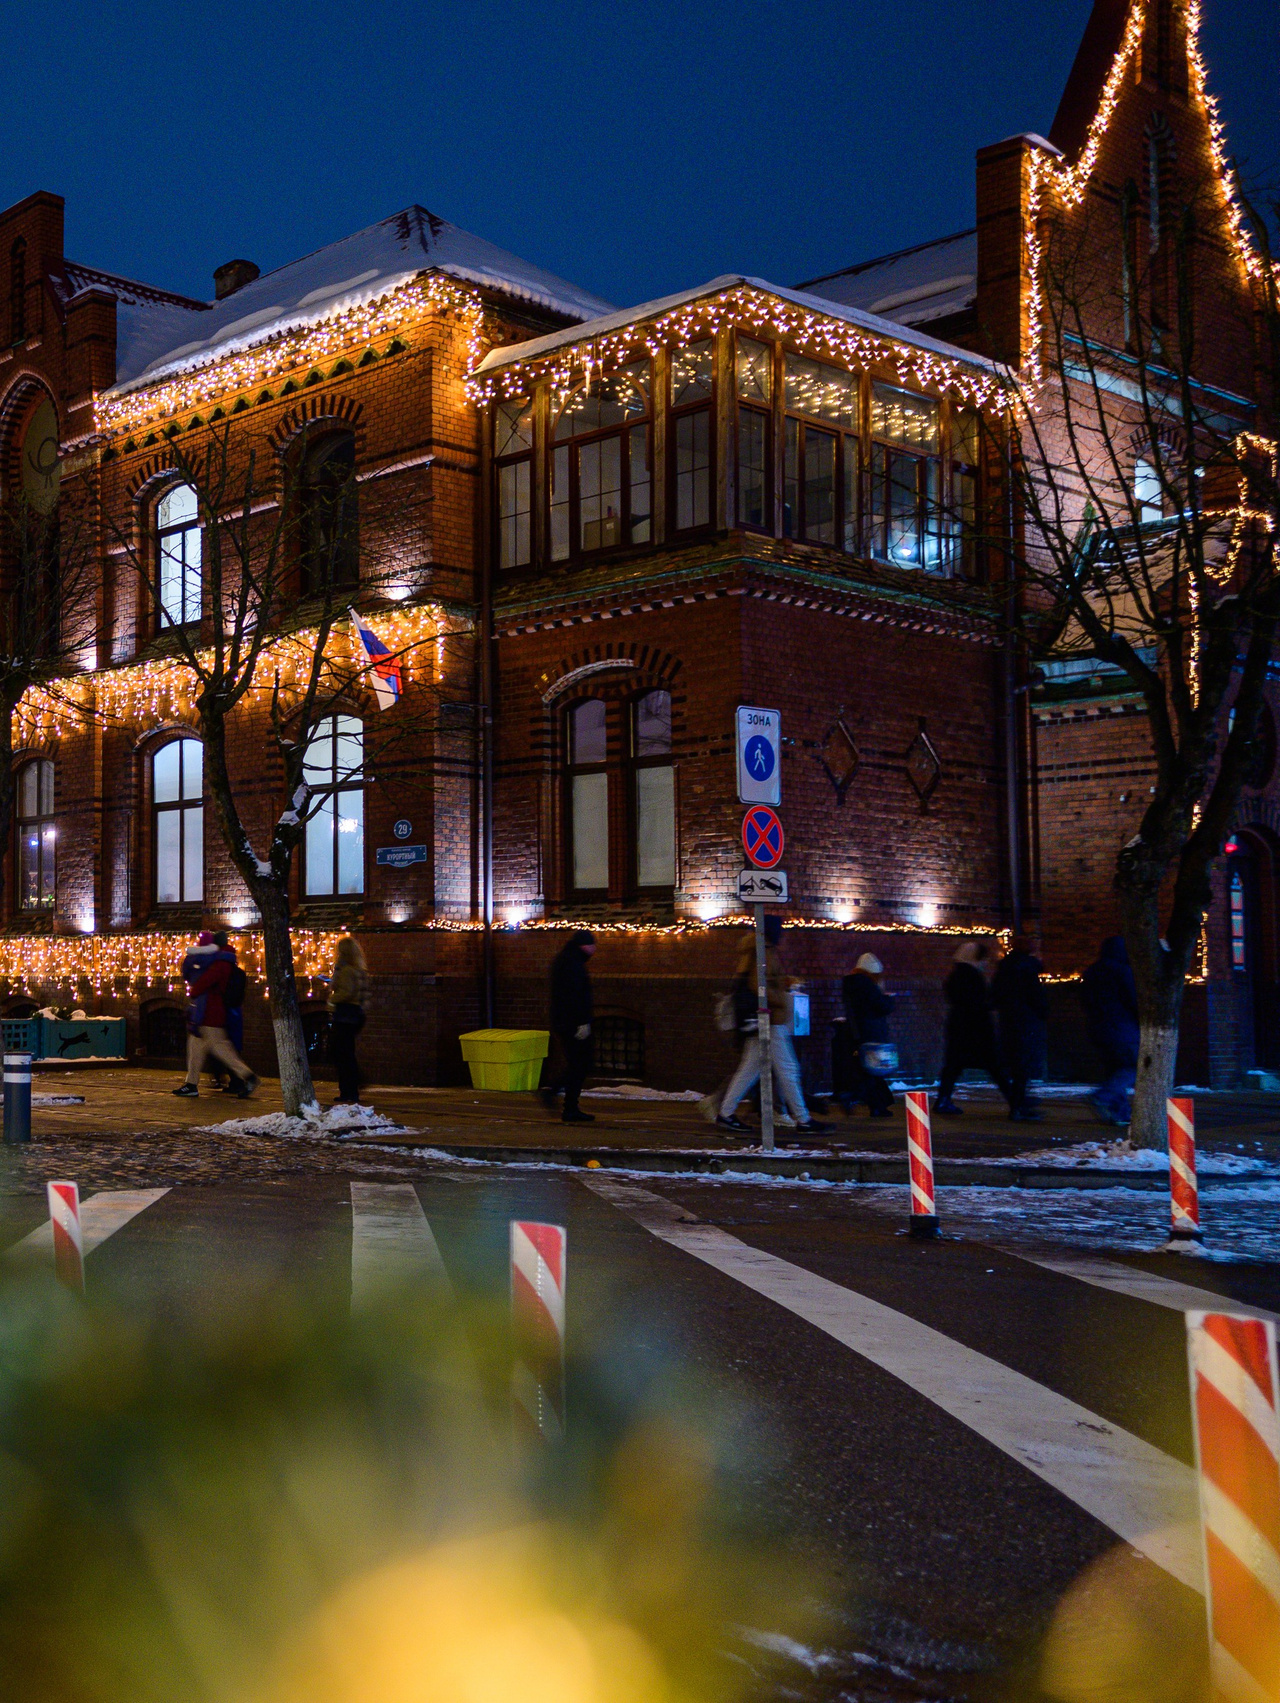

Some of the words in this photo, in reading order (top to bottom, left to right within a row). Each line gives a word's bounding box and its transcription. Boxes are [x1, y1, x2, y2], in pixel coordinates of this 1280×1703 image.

[747, 713, 771, 727] ЗОНА
[398, 824, 408, 835] 29
[386, 852, 416, 861] КУРОРТНЫЙ
